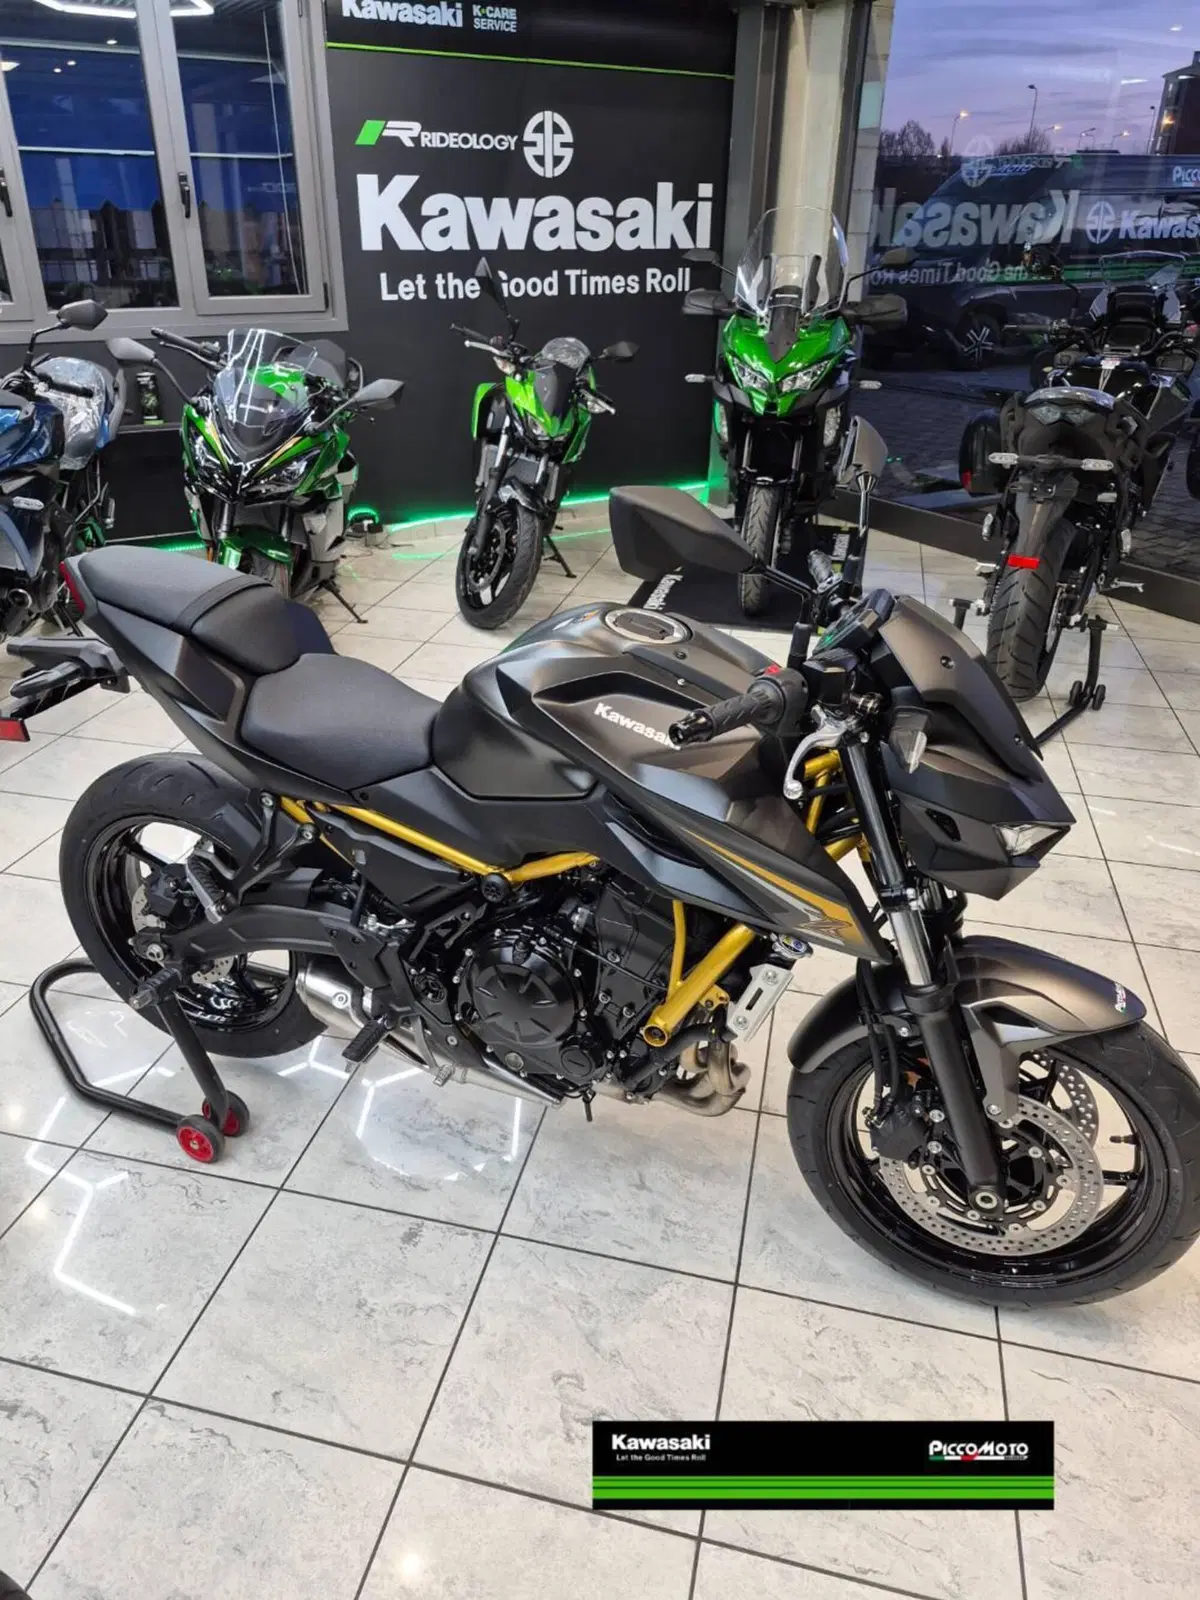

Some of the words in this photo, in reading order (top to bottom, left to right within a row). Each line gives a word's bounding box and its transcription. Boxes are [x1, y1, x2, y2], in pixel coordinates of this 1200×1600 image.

[342, 0, 463, 27] Kawasaki
[473, 19, 517, 32] SERVICE
[420, 132, 518, 150] RIDEOLOGY
[356, 173, 713, 252] Kawasaki
[1118, 210, 1200, 239] Kawas
[380, 272, 426, 300] Let
[436, 272, 480, 299] the
[564, 269, 639, 295] Times
[646, 267, 690, 293] Roll
